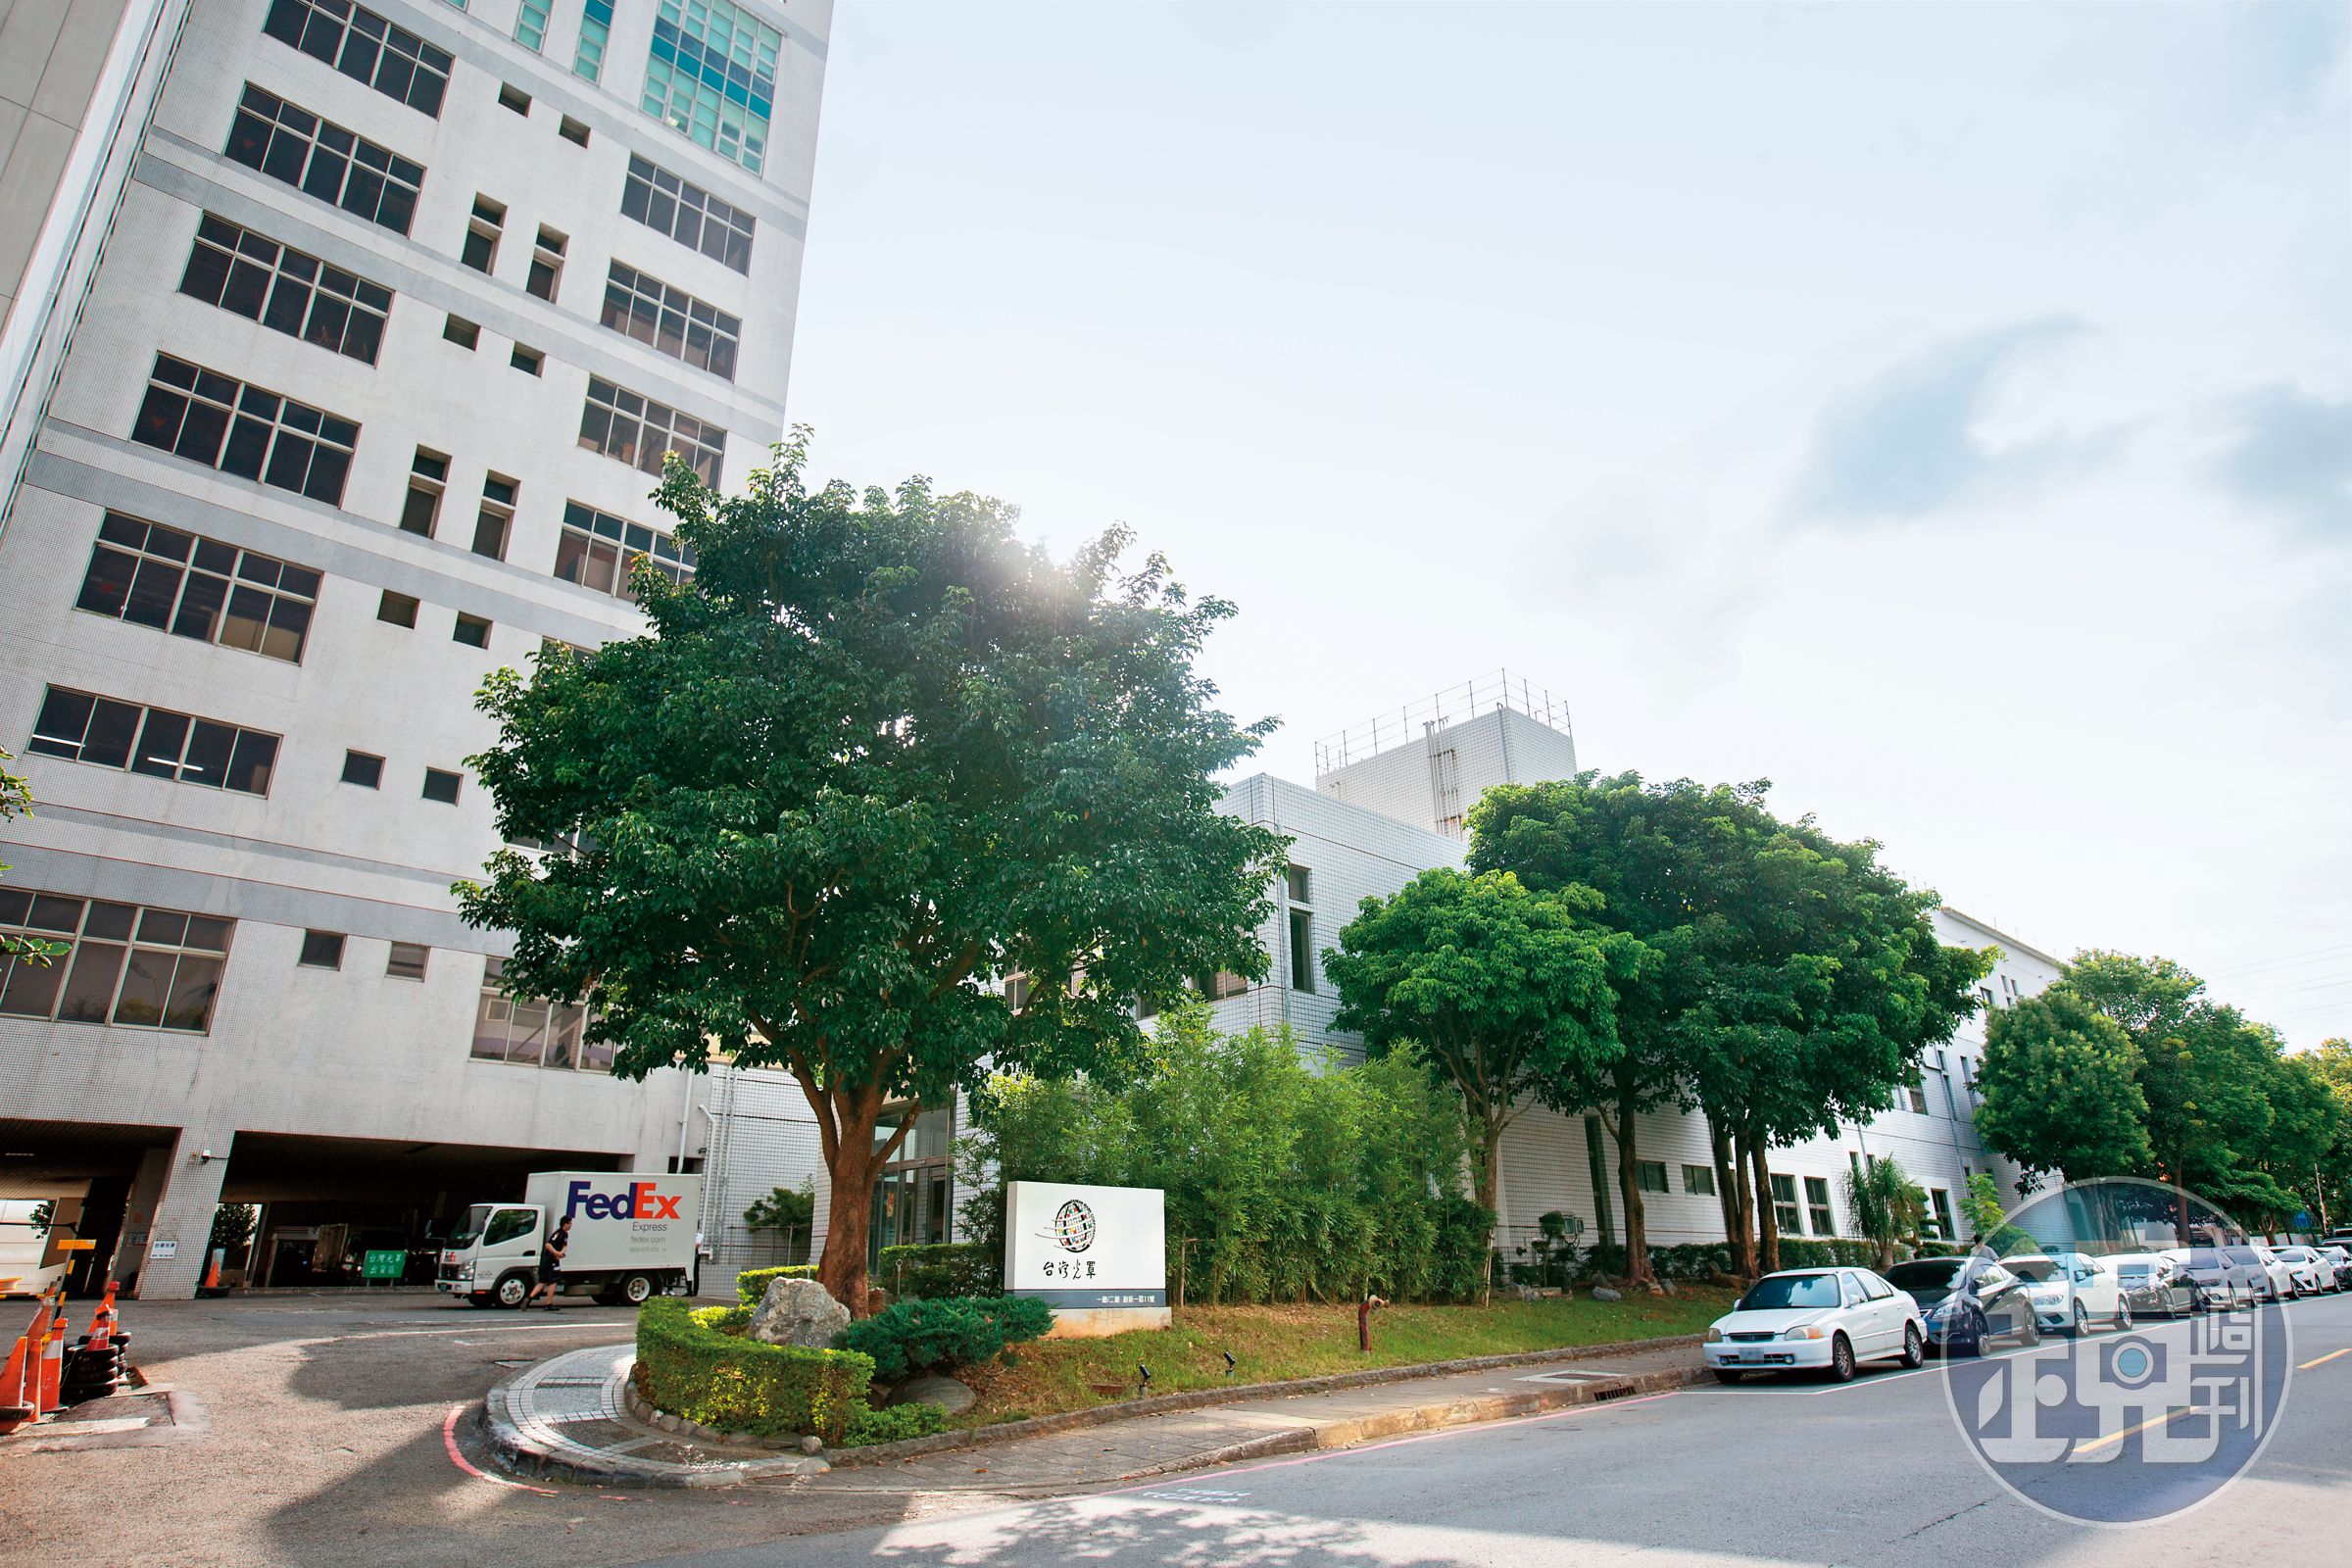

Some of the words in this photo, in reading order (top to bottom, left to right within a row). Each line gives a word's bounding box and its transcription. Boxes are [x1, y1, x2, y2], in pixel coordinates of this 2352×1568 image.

[565, 1181, 683, 1220] FedEx
[632, 1221, 667, 1233] Express
[1043, 1259, 1096, 1280] 台灣光罩
